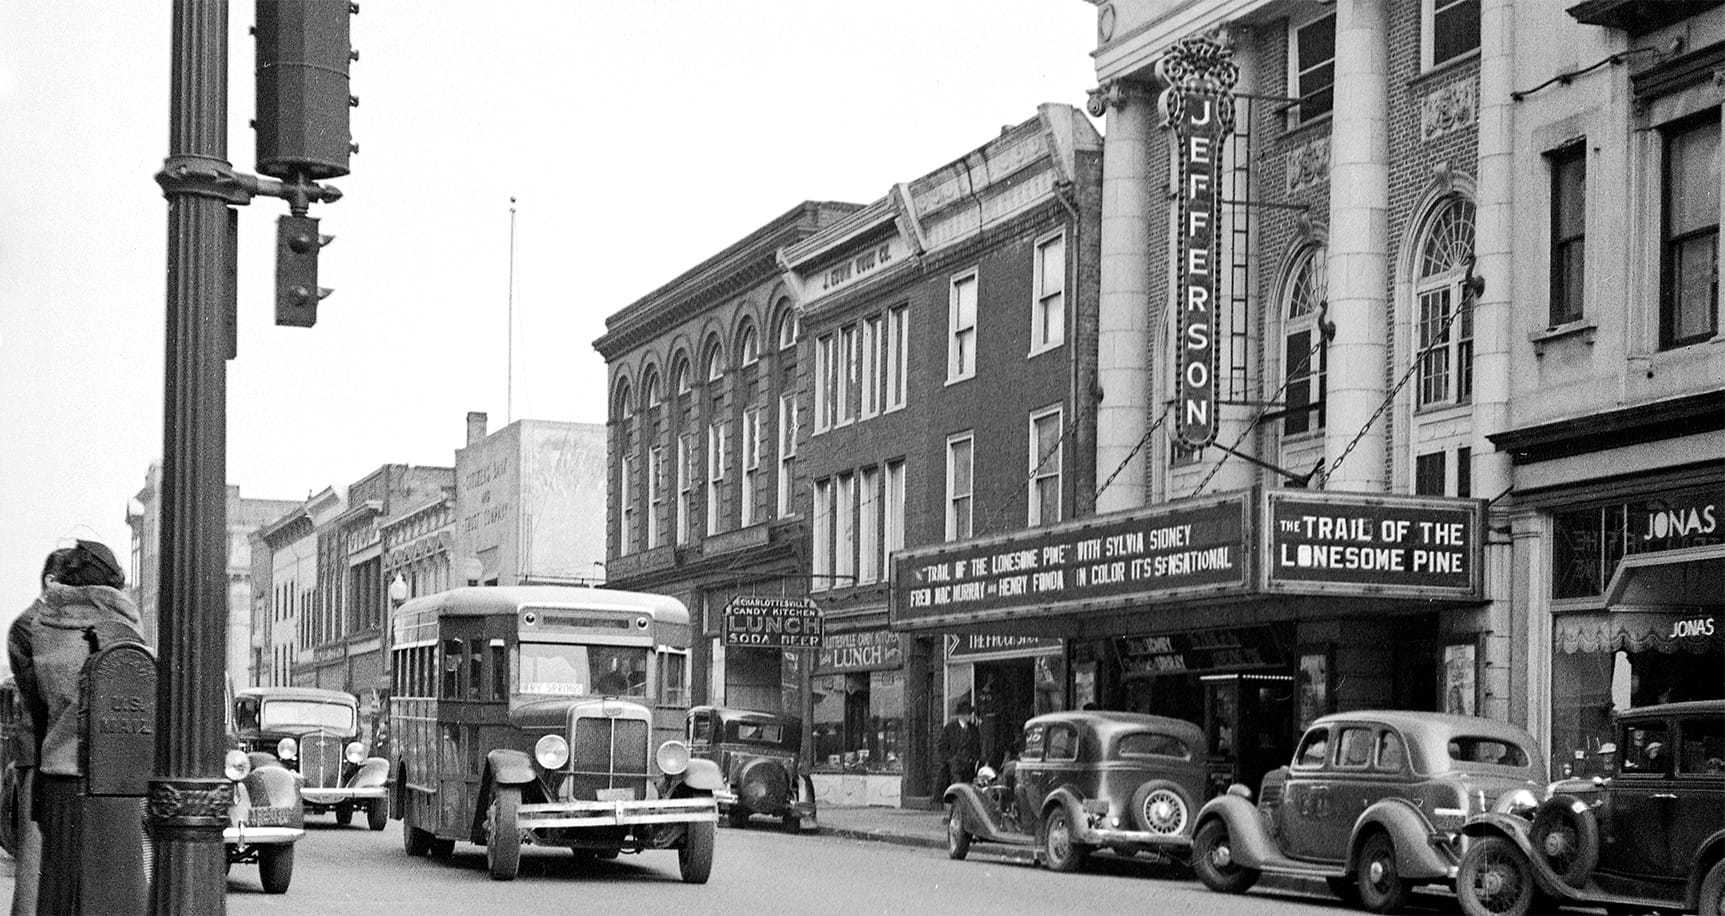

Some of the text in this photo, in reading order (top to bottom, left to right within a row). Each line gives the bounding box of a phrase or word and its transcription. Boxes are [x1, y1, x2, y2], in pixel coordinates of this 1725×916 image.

[1186, 100, 1211, 425] JEFFERSON
[1280, 516, 1464, 545] THE TRAIL OF THE
[1644, 504, 1716, 541] JONAS
[955, 560, 967, 579] OF
[971, 557, 988, 577] THE
[992, 549, 1038, 574] LONESOME
[1077, 538, 1101, 561] WITH
[1106, 532, 1144, 557] SYLVIA
[1150, 524, 1191, 550] SIDNEY
[1281, 543, 1463, 573] LONESOME PINE
[910, 588, 931, 608] FRED
[934, 586, 951, 605] MAC
[952, 581, 985, 603] MURRAY
[999, 575, 1028, 597] HENRY
[1033, 570, 1064, 592] FONDA
[1076, 567, 1087, 587] IN
[1092, 561, 1125, 585] COLOR
[1155, 546, 1232, 577] SENSATIONAL
[729, 615, 820, 634] LUNCH
[733, 607, 815, 617] CANDY KITCHEN
[729, 633, 819, 646] SODA BEER
[1670, 618, 1714, 639] JONAS
[834, 645, 882, 668] LUNCH
